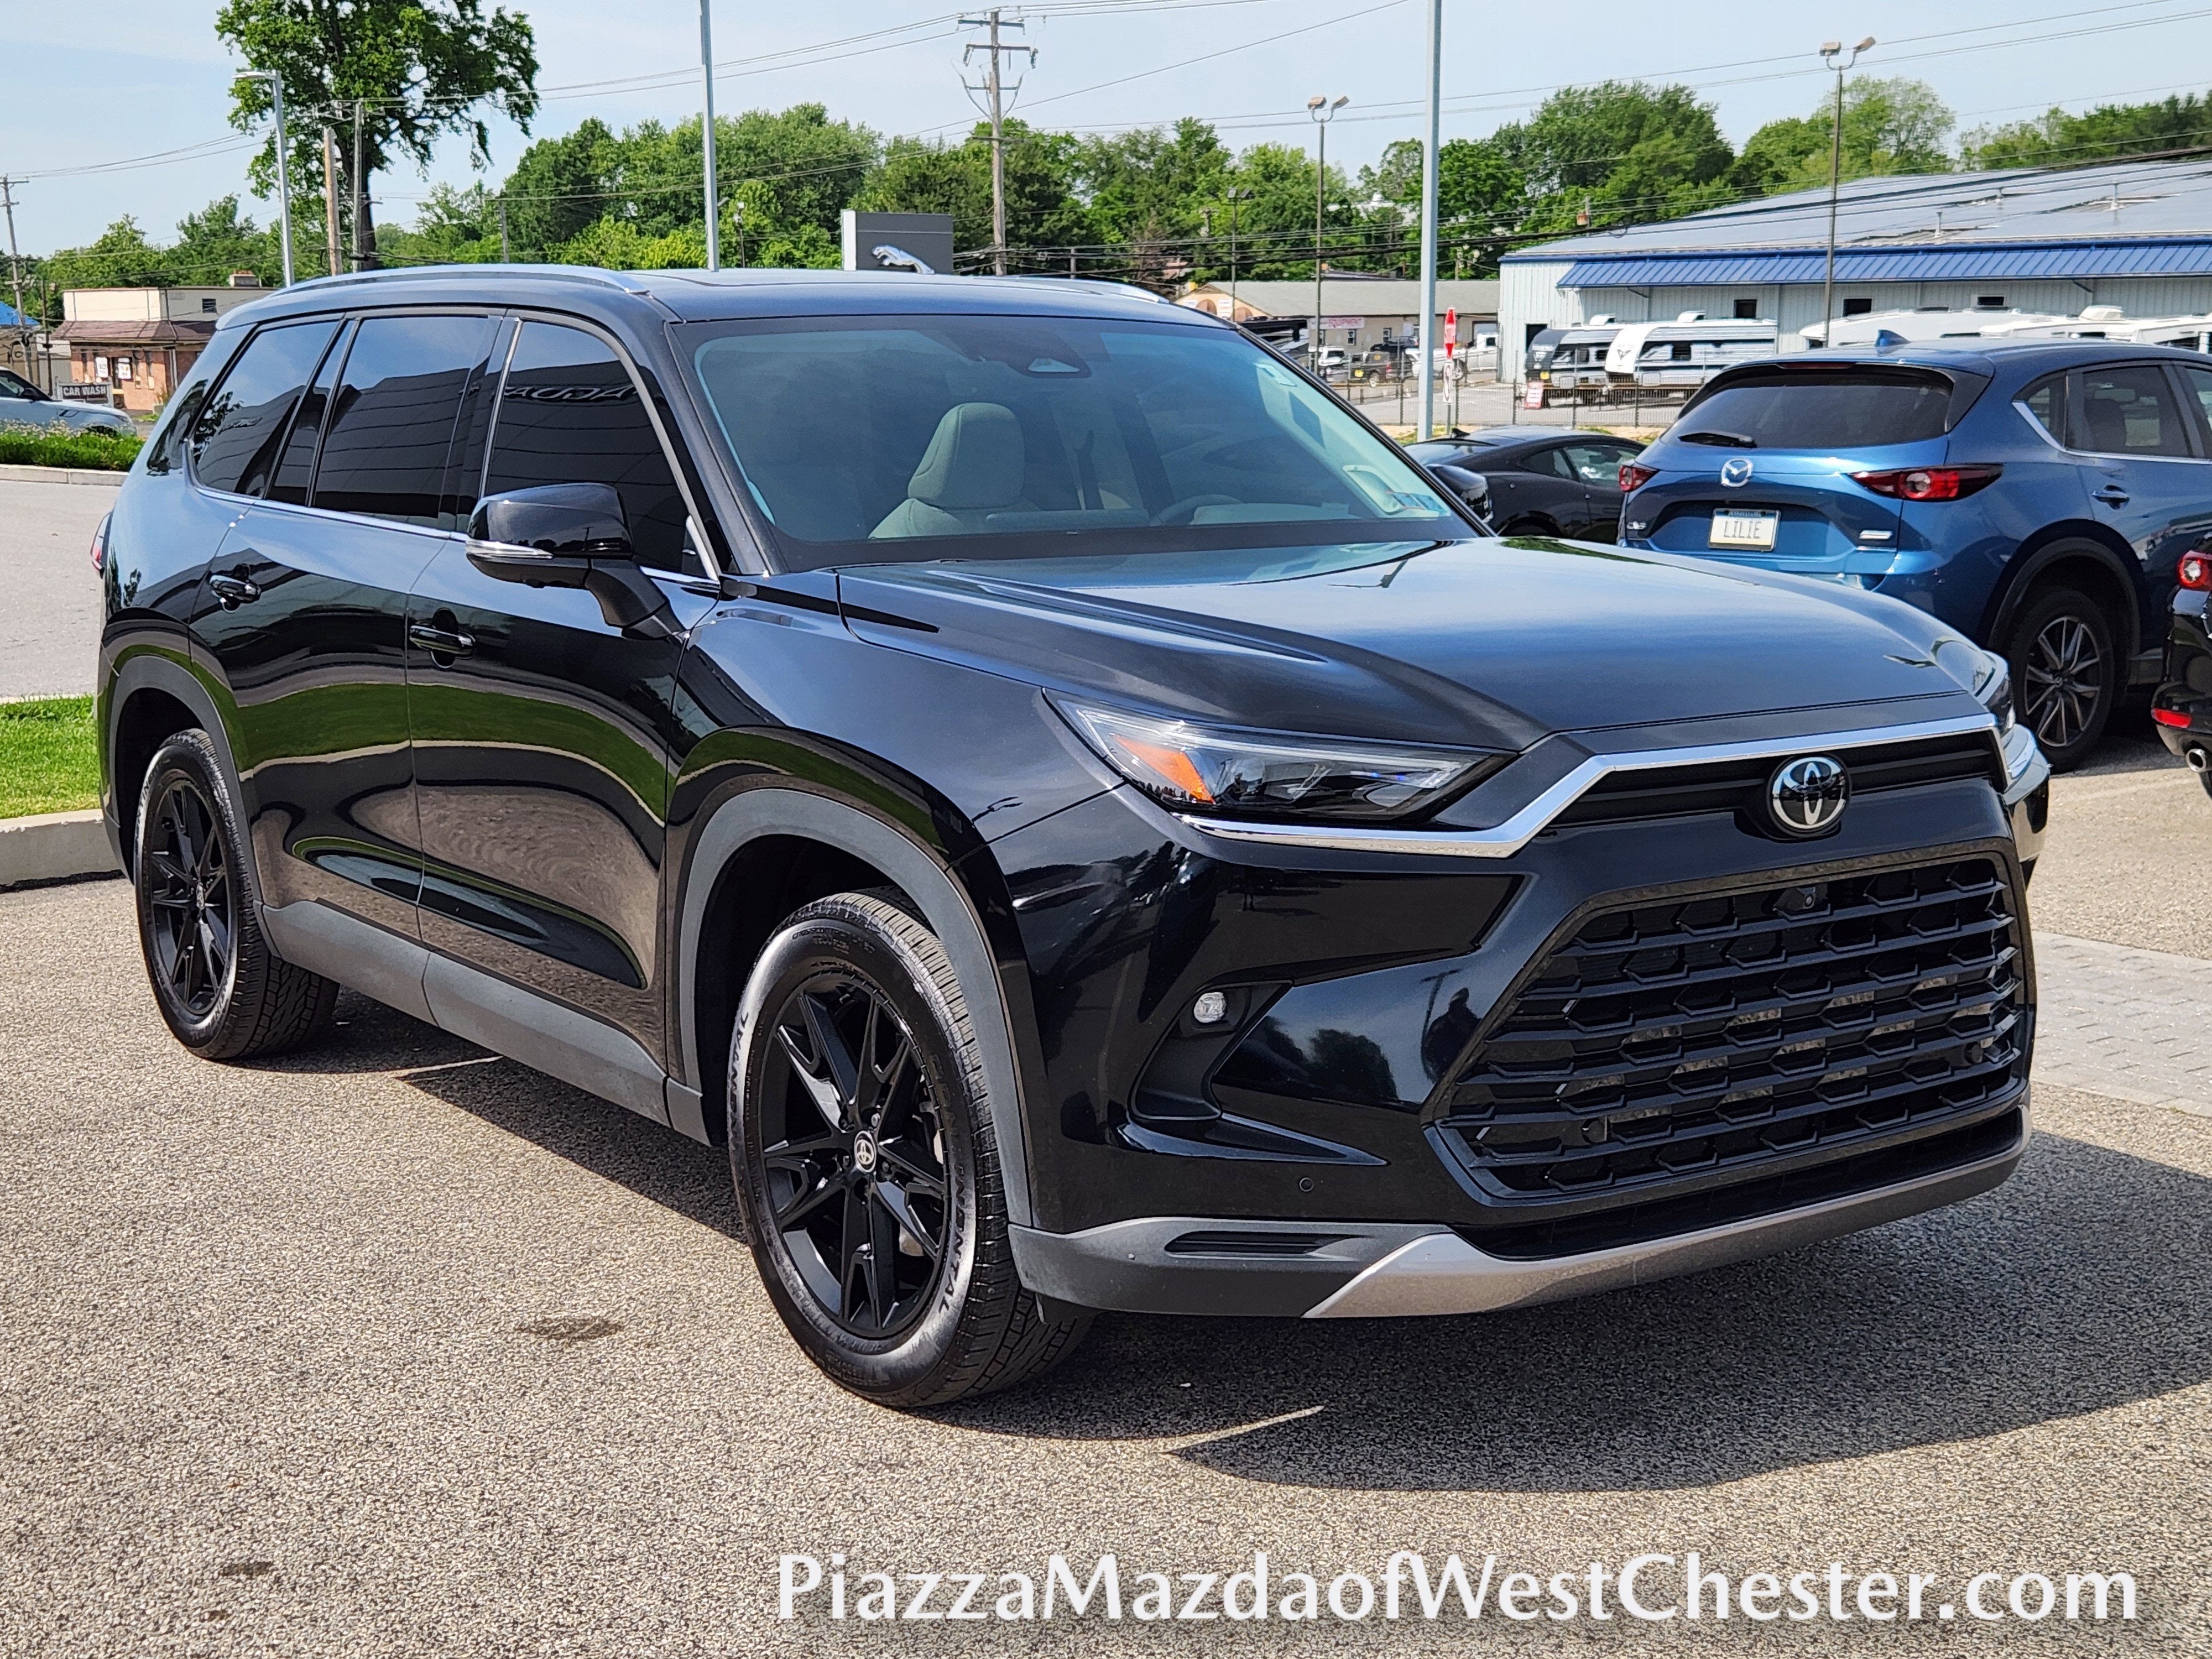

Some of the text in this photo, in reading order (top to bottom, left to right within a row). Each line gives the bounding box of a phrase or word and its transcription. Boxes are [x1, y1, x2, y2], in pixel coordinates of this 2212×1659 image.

[63, 386, 106, 396] CAR WASH
[1724, 521, 1762, 539] LILIE
